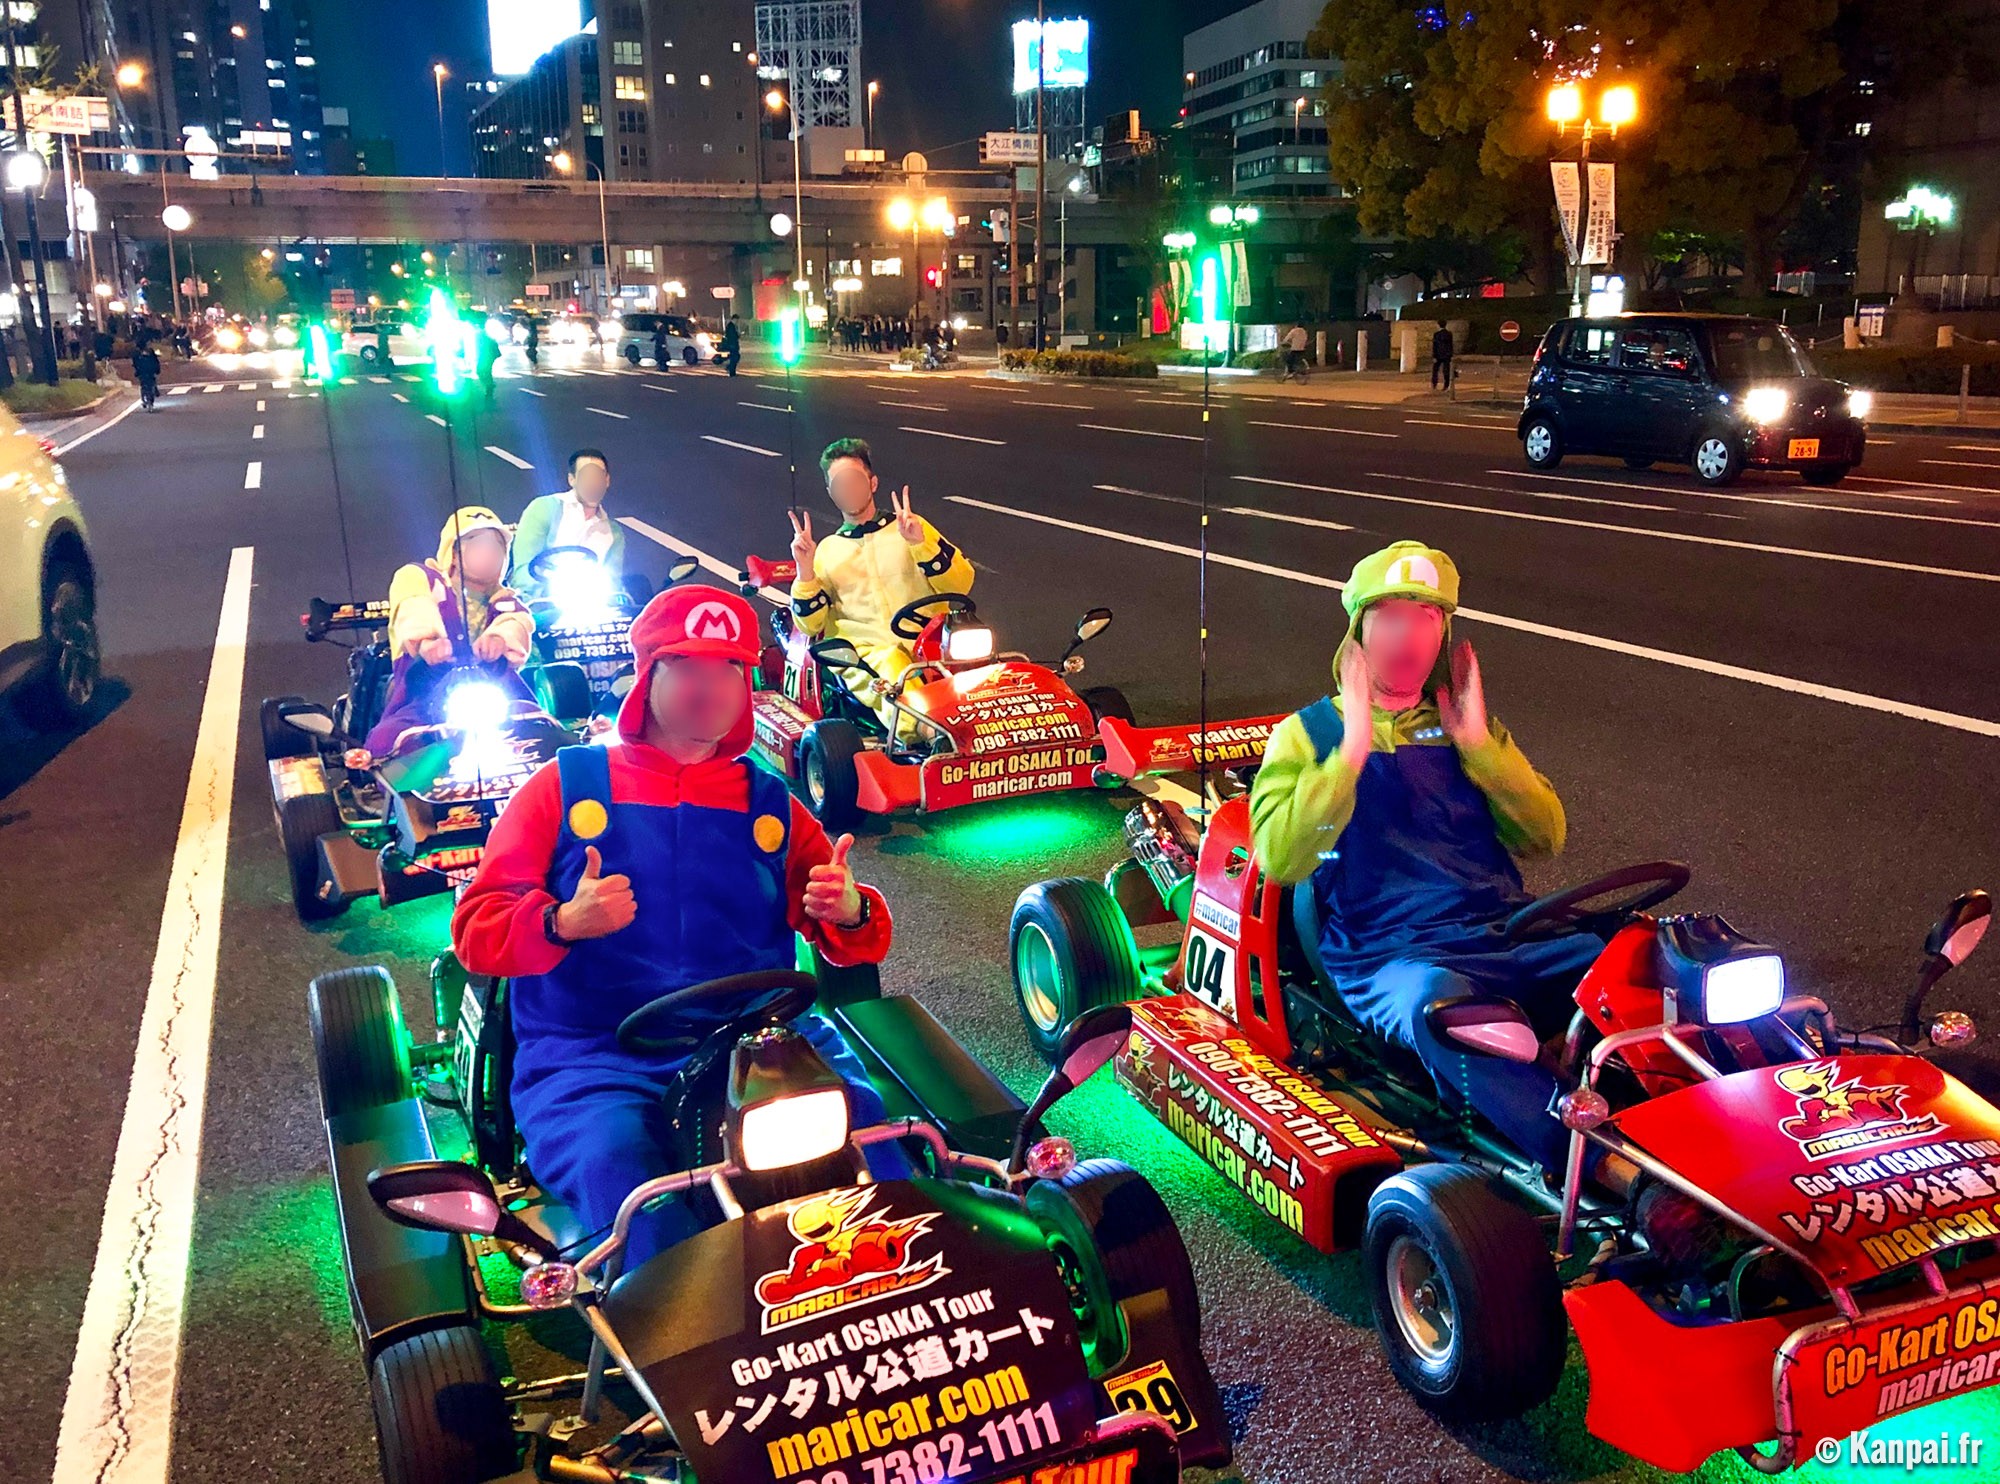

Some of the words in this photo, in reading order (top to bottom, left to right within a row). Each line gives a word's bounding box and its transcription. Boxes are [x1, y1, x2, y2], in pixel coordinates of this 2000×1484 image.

[1795, 446, 1816, 457] 28-91
[1402, 560, 1426, 585] L
[692, 608, 736, 639] M
[785, 665, 797, 699] 21
[946, 699, 1078, 725] レンタル公道カート
[957, 700, 998, 713] Go-Kart
[998, 694, 1033, 706] OSAKA
[1031, 692, 1056, 701] Tour
[972, 723, 1082, 753] 090-7382-1111
[974, 712, 1070, 736] maricar.com
[941, 758, 1005, 785] Go-Kart
[1008, 750, 1063, 774] OSAKA
[1191, 743, 1251, 764] Go-Kart
[972, 770, 1073, 799] maricar.com
[1195, 902, 1239, 936] #maricar
[1186, 935, 1227, 1006] 04
[1186, 1041, 1350, 1157] 090-7382-1111
[1221, 1038, 1286, 1079] Go-Kart
[1275, 1077, 1342, 1116] OSAKA
[1325, 1114, 1381, 1149] Tour
[1167, 1061, 1305, 1189] レンタル公道カート
[1807, 1122, 1908, 1156] MARICAR
[1167, 1097, 1305, 1236] maricar.com
[1793, 1158, 1891, 1197] Go-Kart
[1878, 1144, 1962, 1175] OSAKA
[769, 1273, 900, 1326] MARICAR
[731, 1336, 840, 1387] Go-Kart
[841, 1306, 934, 1351] OSAKA
[930, 1287, 995, 1324] Tour
[1826, 1316, 1949, 1395] Go-Kart
[1954, 1299, 2000, 1349] OS
[694, 1307, 1055, 1446] レンタル公道カート
[767, 1365, 1030, 1479] maricar.com
